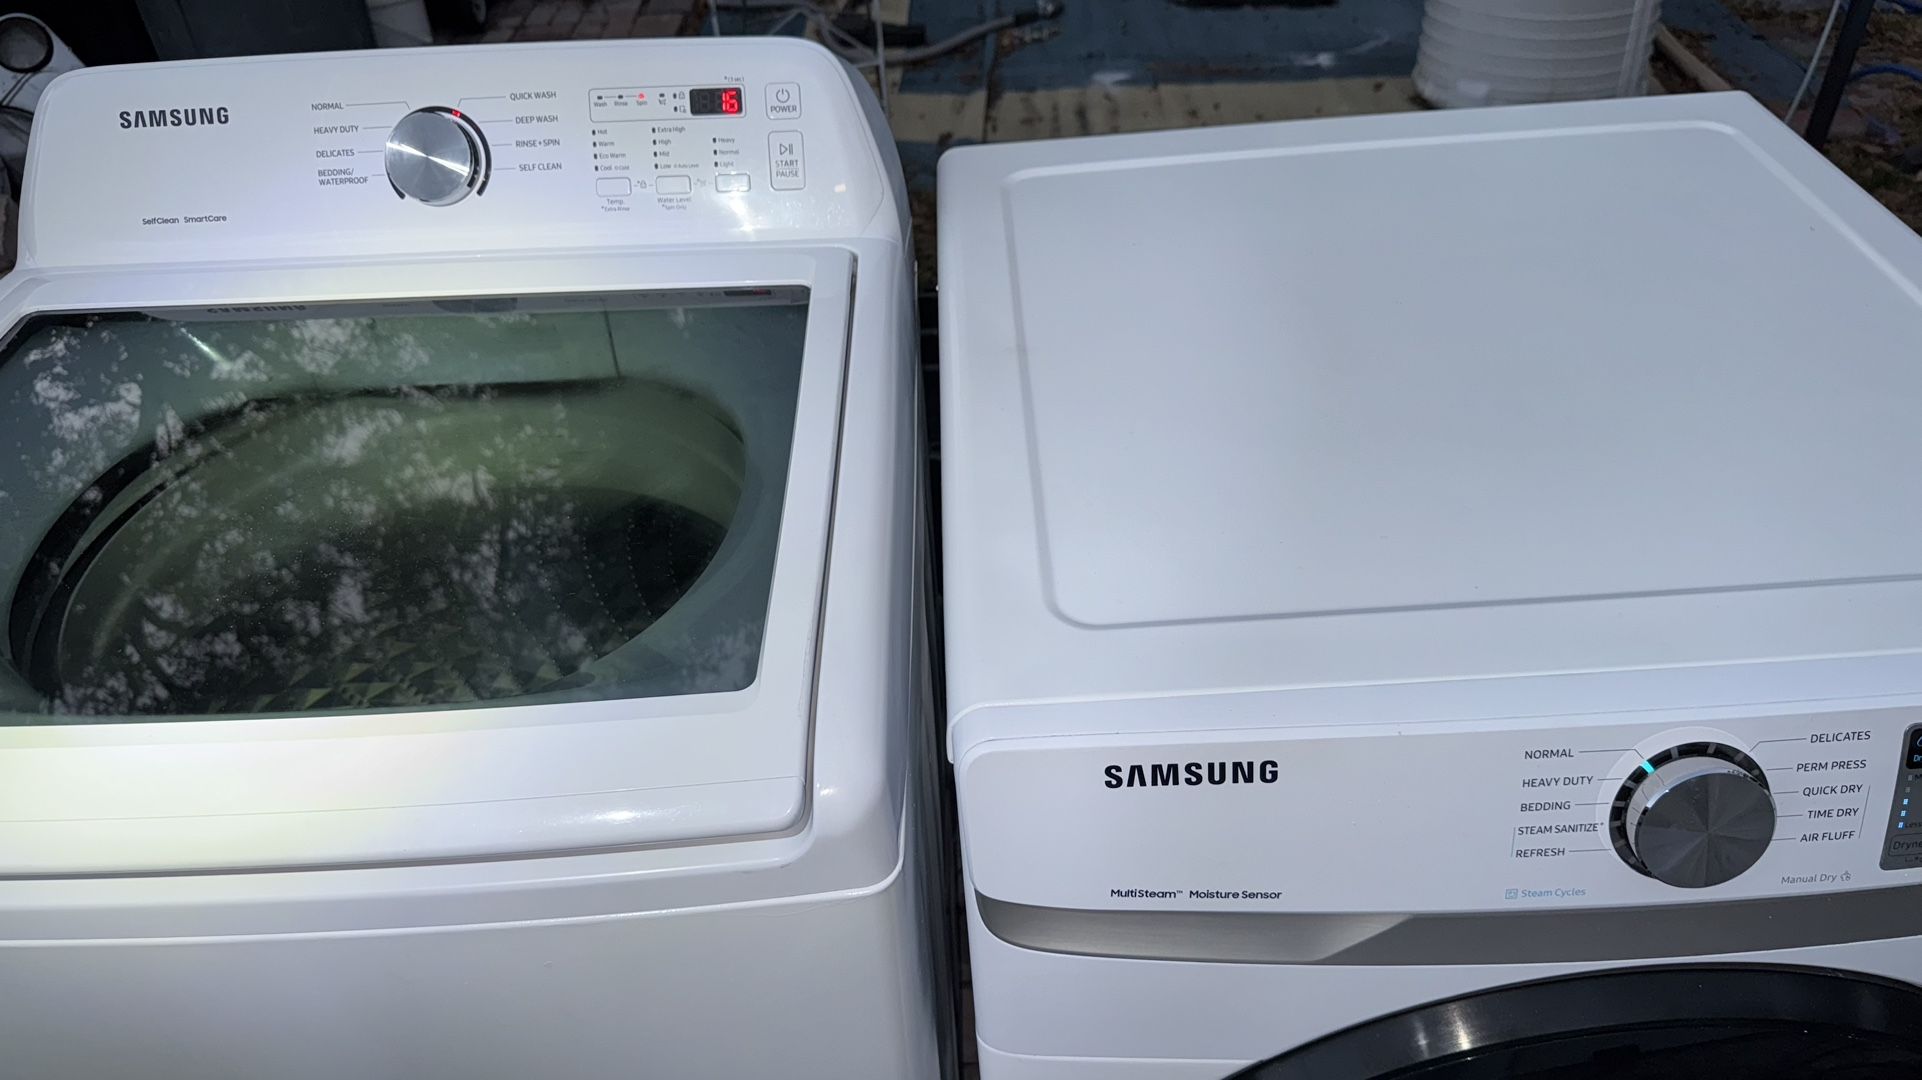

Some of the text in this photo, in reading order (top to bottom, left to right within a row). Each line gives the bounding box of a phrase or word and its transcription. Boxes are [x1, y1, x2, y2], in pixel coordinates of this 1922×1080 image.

[510, 91, 557, 101] QUICK WASH
[311, 102, 344, 111] NORMAL
[770, 105, 797, 113] POWER
[119, 106, 229, 129] SAMSUNG
[515, 115, 559, 124] DEEP WASH
[313, 125, 359, 134] HEAVY DUTY
[316, 149, 355, 158] DELICATES
[519, 162, 562, 172] SELF CLEAN
[775, 160, 799, 168] START
[318, 168, 354, 177] BEDDING/
[776, 169, 800, 178] PAUSE
[318, 176, 369, 186] WATERPROOF
[142, 214, 227, 225] SelfClean SmartCare
[1810, 730, 1871, 744] DELICATES
[1524, 749, 1574, 760] NORMAL
[1796, 759, 1867, 772] PERM PRESS
[1104, 760, 1279, 789] SAMSUNG
[1522, 776, 1594, 788] HEAVY DUTY
[1802, 784, 1863, 797] QUICK DRY
[1520, 801, 1571, 812] BEDDING
[1807, 808, 1860, 819] TIME DRY
[1518, 825, 1555, 836] STEAM
[1800, 830, 1856, 843] AIR FLUFF
[1515, 848, 1566, 858] REFRESH
[1781, 873, 1837, 884] Manual Dry
[1189, 889, 1240, 899] Moisture
[1241, 890, 1282, 900] Sensor
[1521, 887, 1587, 898] Steam Cycles
